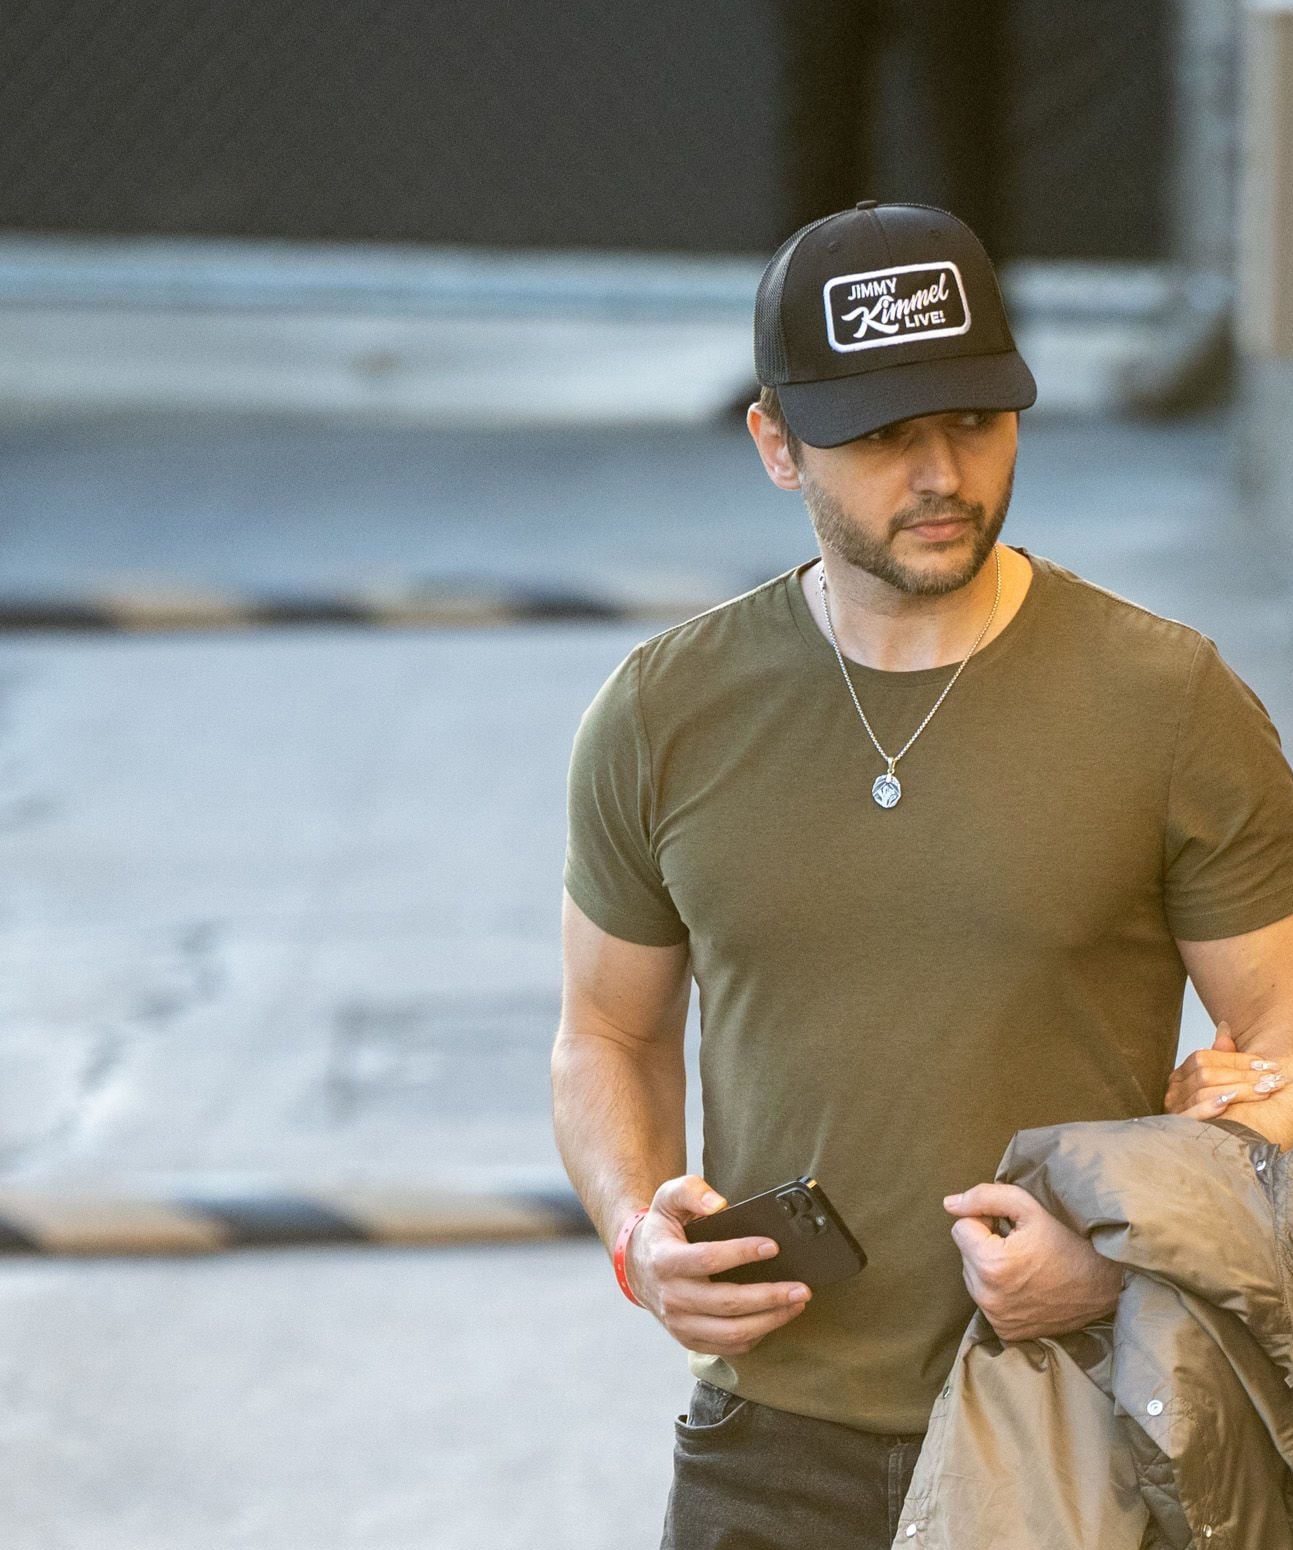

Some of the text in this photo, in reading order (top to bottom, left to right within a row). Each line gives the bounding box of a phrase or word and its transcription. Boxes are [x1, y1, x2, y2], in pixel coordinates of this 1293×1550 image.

[847, 277, 897, 301] JIMMY
[841, 272, 949, 339] Kimmel
[904, 310, 946, 328] LIVE!
